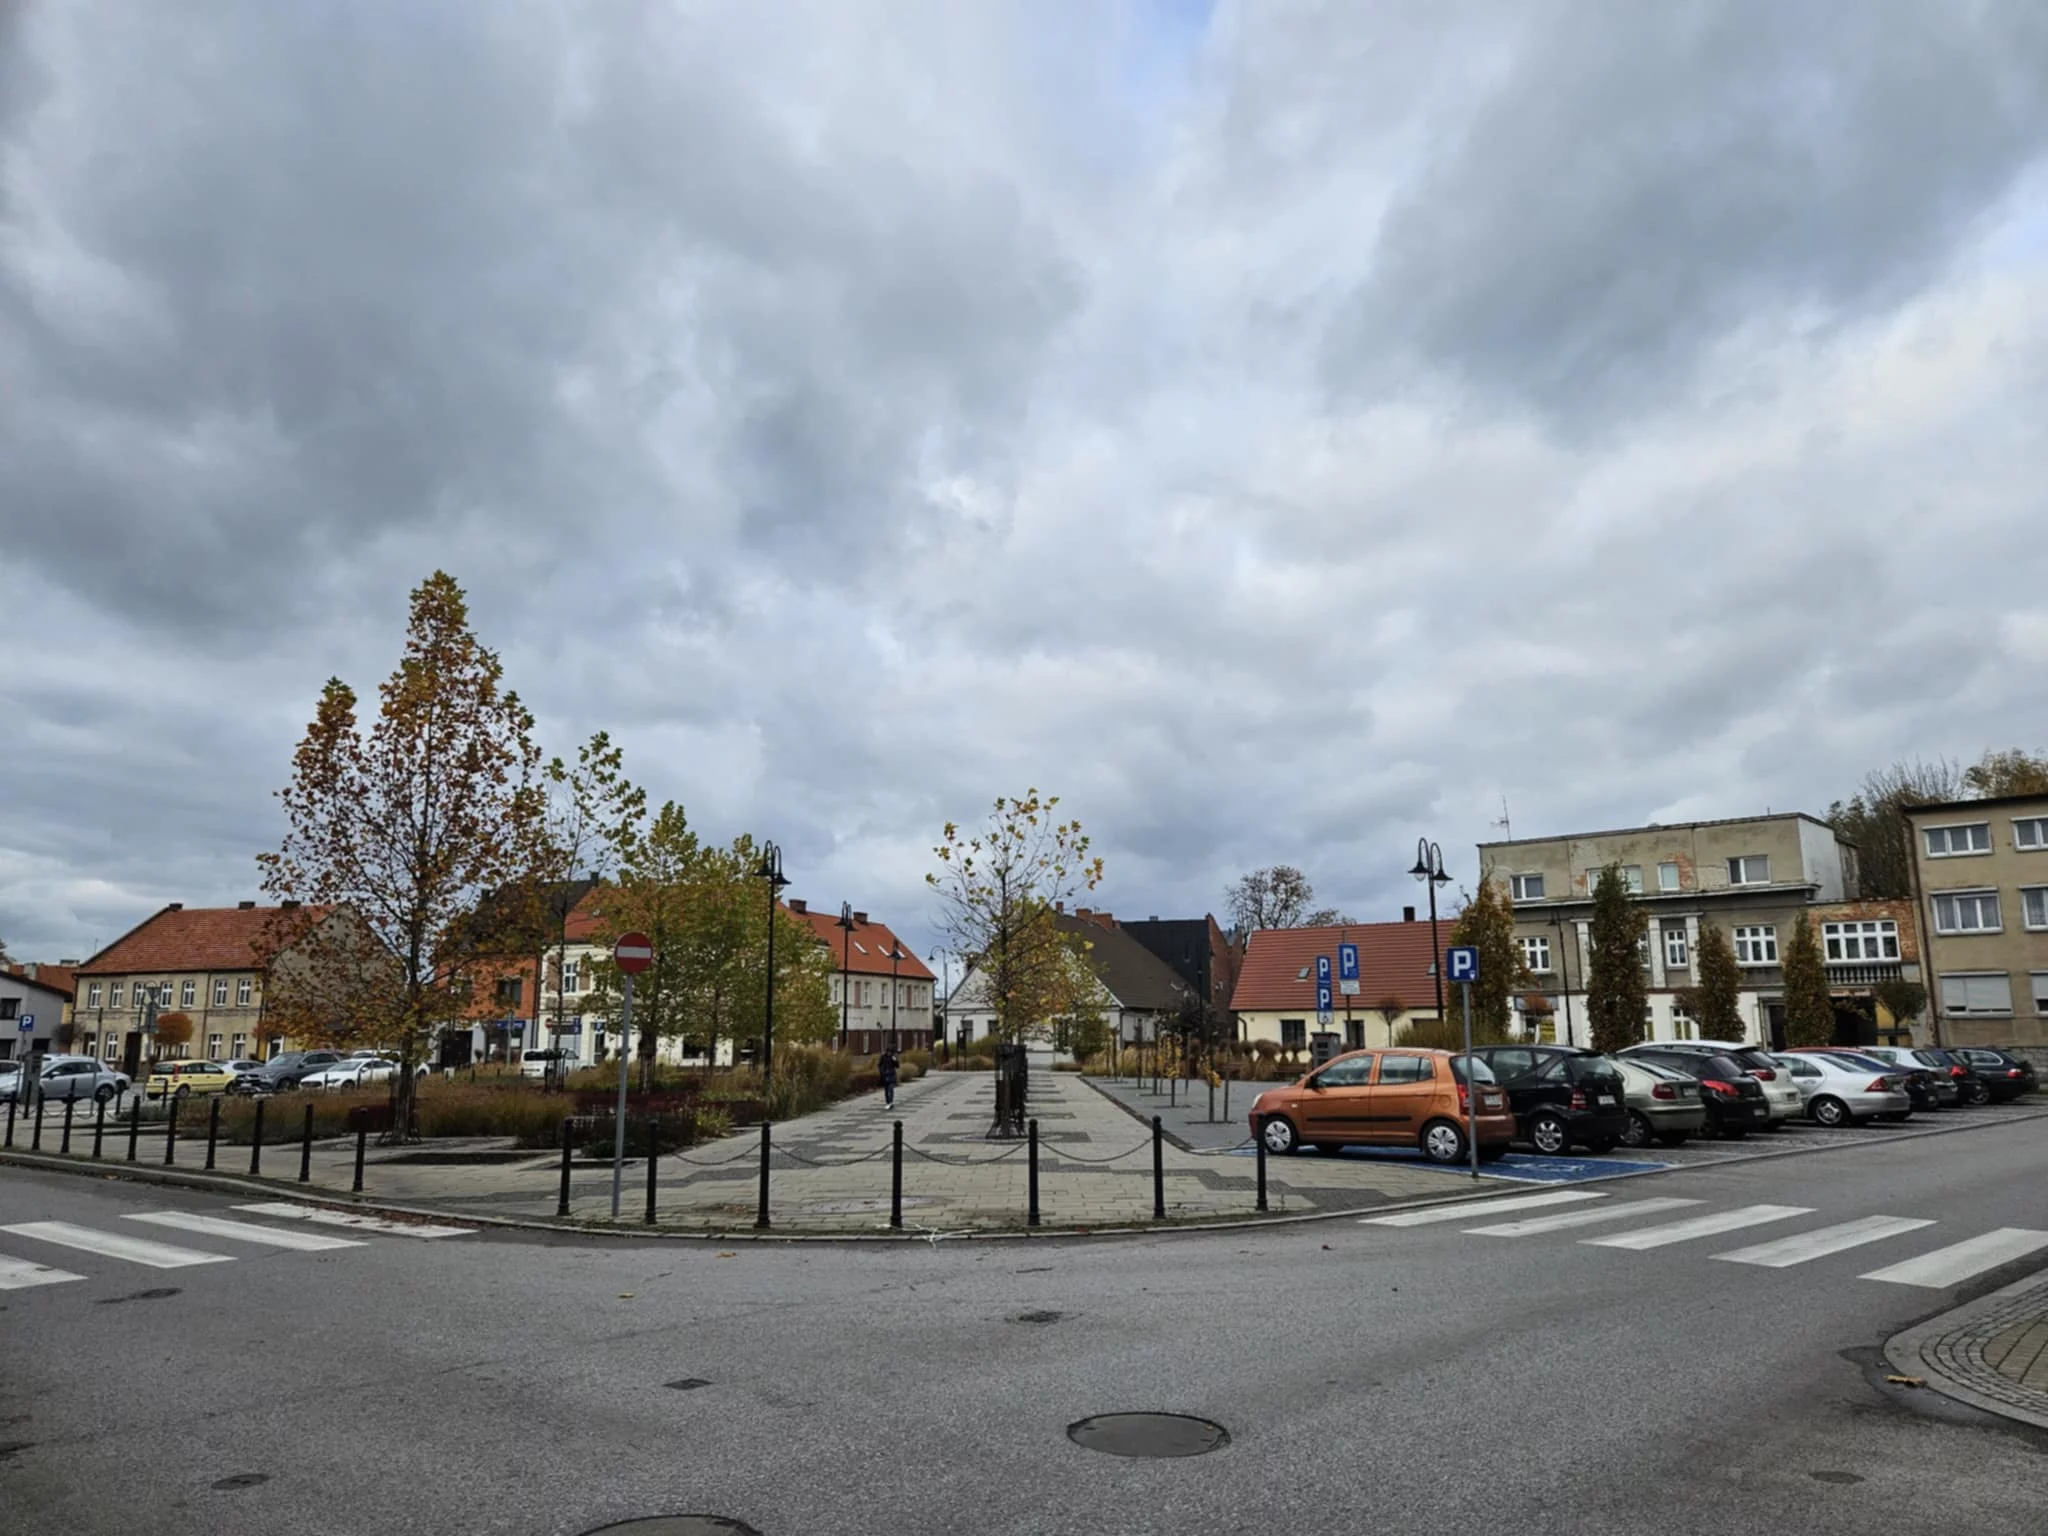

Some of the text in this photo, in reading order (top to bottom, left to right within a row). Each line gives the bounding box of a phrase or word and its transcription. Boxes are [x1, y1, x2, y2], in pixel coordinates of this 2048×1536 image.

[1319, 958, 1329, 977] P
[1342, 947, 1355, 976] P
[1453, 951, 1471, 977] P
[1320, 988, 1330, 1009] P
[22, 1015, 32, 1027] P
